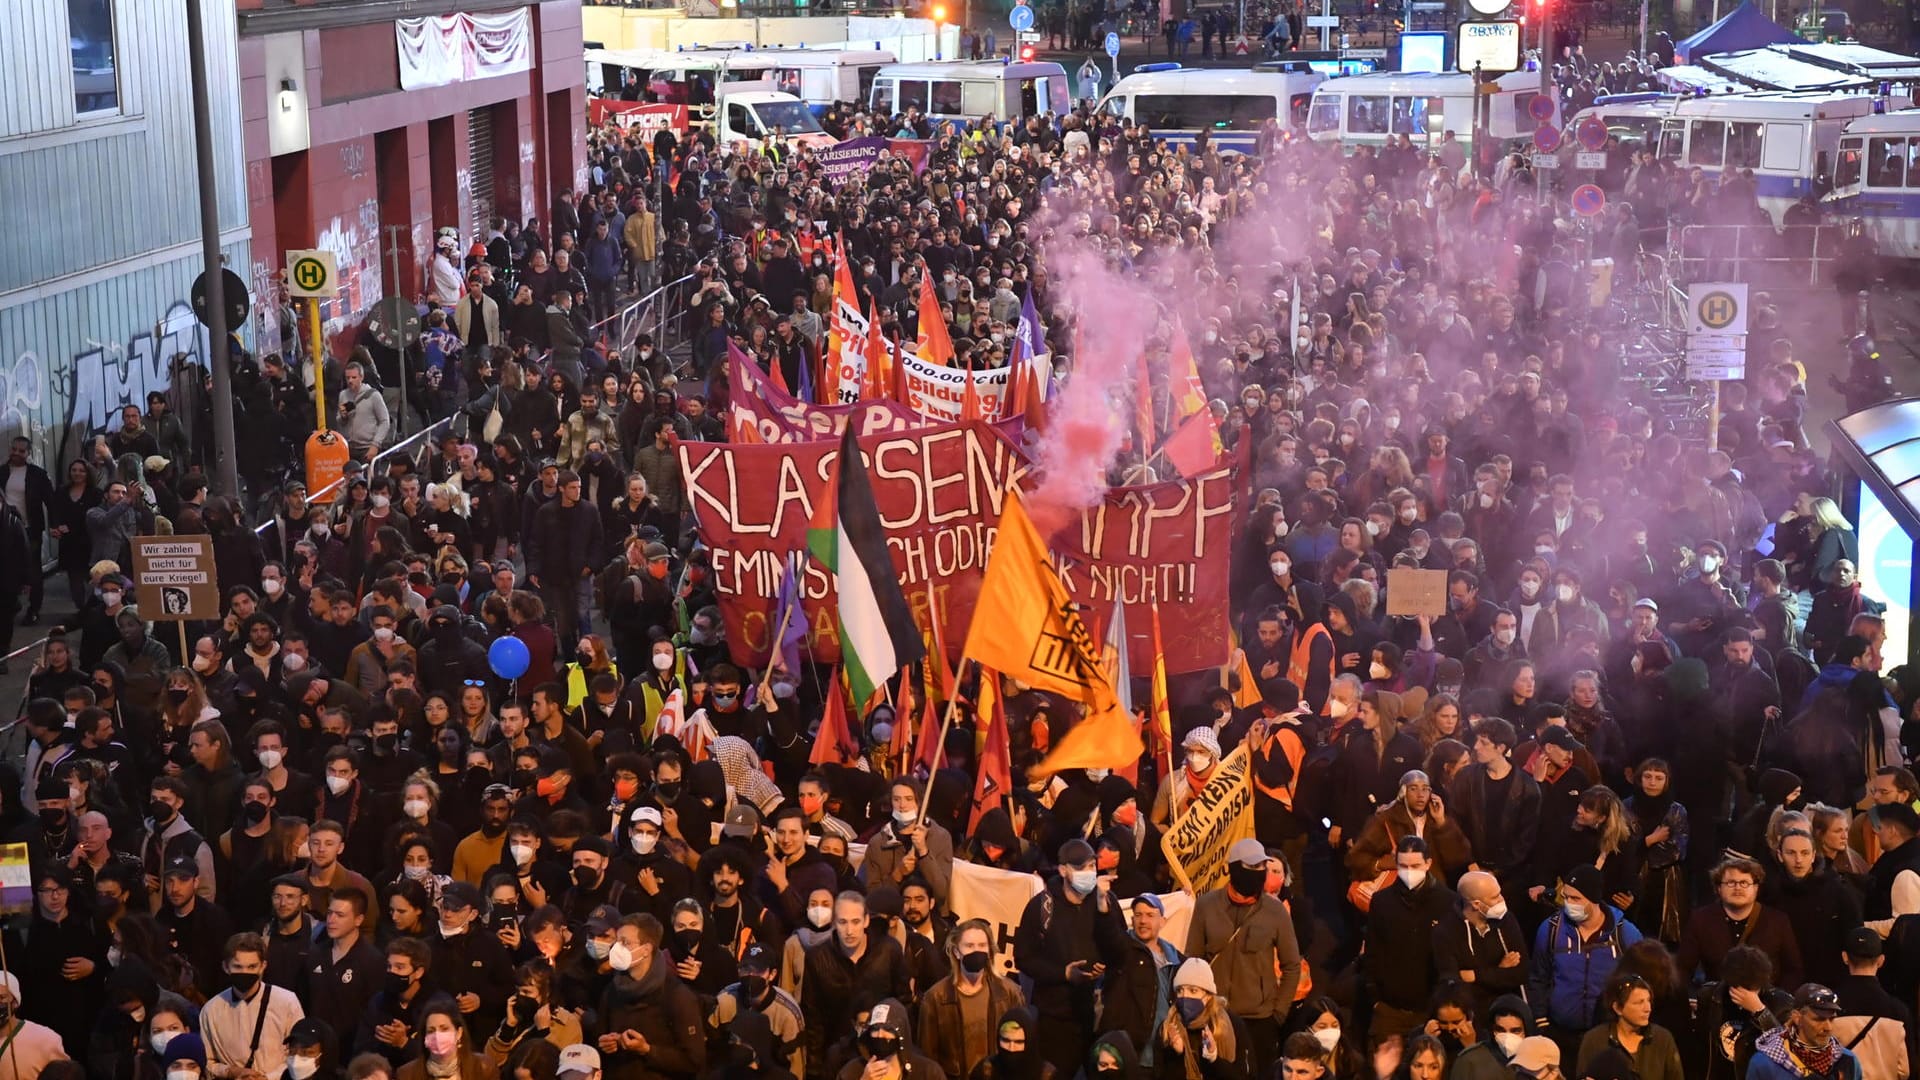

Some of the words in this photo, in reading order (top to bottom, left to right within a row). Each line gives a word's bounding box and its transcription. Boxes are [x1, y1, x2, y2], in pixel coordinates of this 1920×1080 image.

[301, 265, 318, 284] H
[1708, 299, 1727, 321] H
[143, 545, 160, 554] Wir
[164, 545, 194, 554] zahlen
[151, 560, 175, 569] nicht
[143, 574, 165, 583] eure
